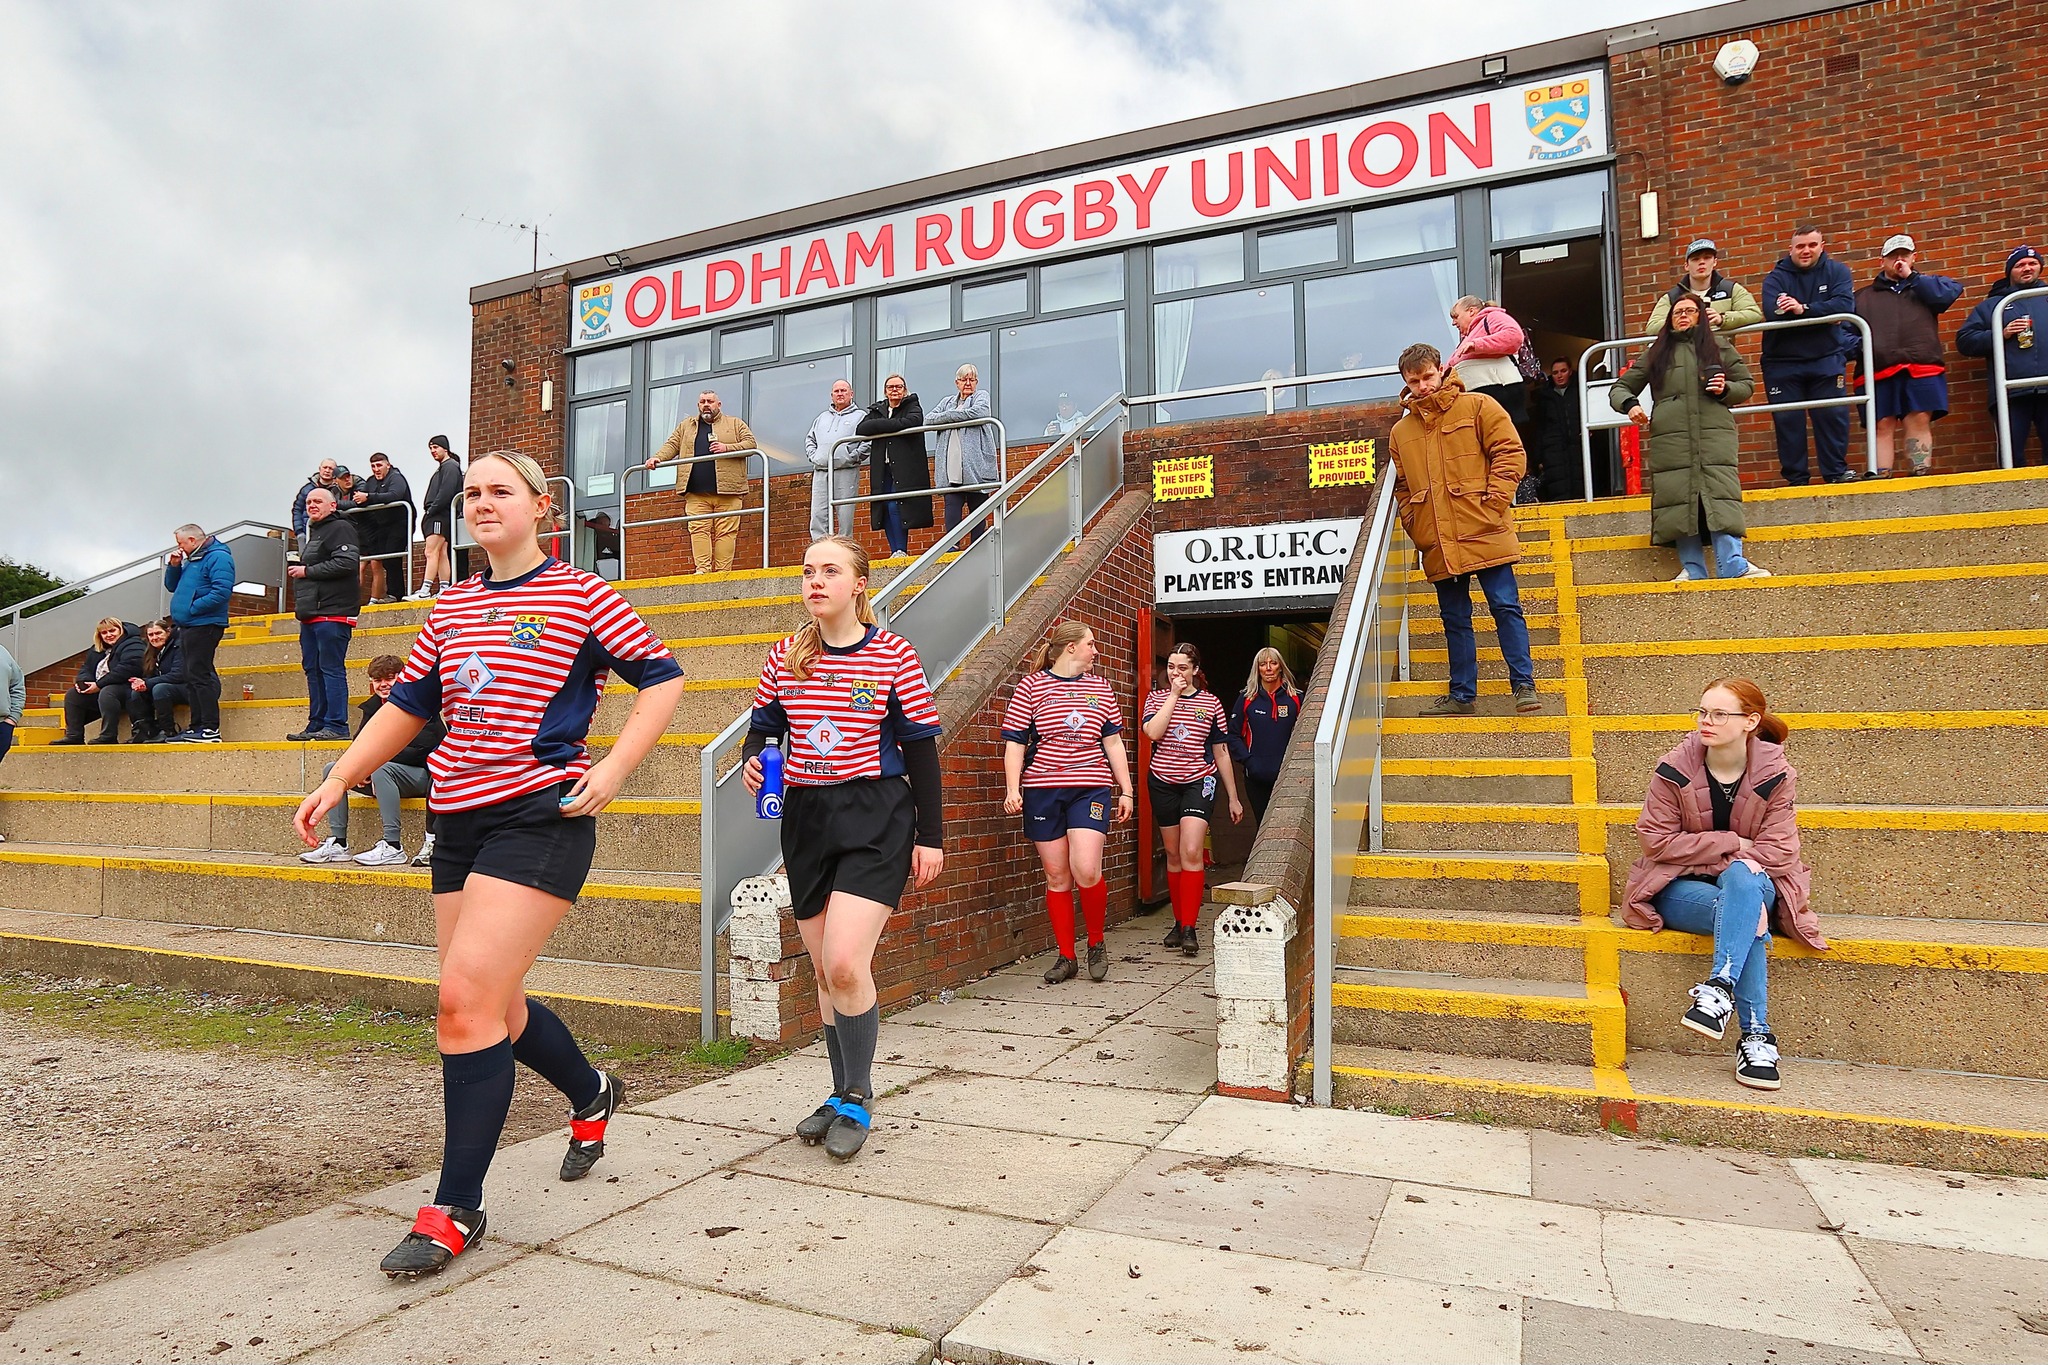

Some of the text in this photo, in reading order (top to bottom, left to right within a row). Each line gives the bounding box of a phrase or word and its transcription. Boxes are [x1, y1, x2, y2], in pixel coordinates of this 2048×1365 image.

[625, 102, 1494, 329] OLDHAM RUGBY UNION
[1314, 444, 1370, 458] PLEASE USE
[1157, 460, 1209, 473] PLEASE USE
[1317, 457, 1367, 471] THE STEPS
[1160, 472, 1206, 485] THE STEPS
[1318, 471, 1366, 483] PROVIDED
[1161, 485, 1205, 497] PROVIDED
[1184, 529, 1347, 564] O.R.U.F.C.
[1164, 564, 1349, 593] PLAYER'S ENTRAN
[468, 669, 480, 684] R
[782, 687, 806, 698] Teejac
[1072, 716, 1079, 725] R
[820, 730, 830, 743] R
[804, 760, 838, 775] REEL
